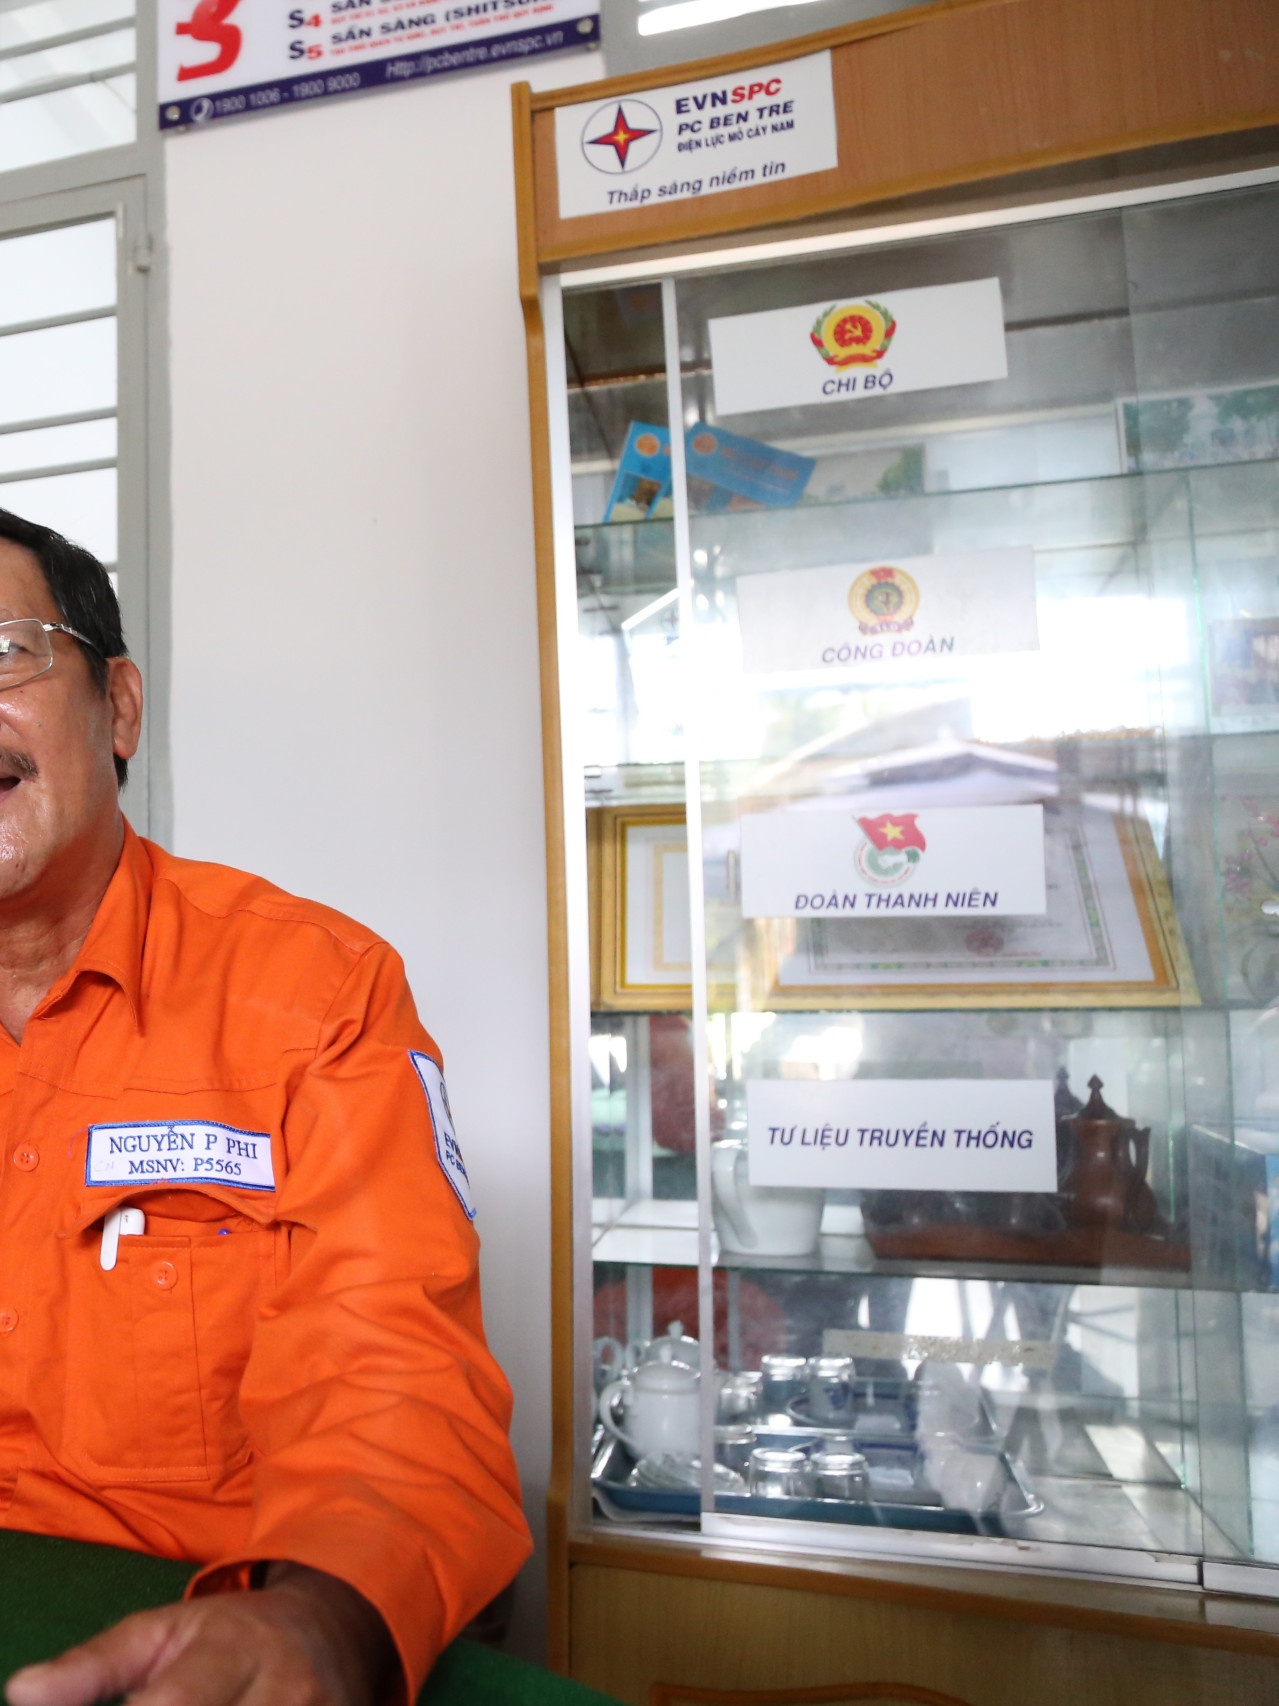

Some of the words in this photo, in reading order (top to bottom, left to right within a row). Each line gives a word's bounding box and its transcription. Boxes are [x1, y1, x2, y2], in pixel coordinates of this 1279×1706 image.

[288, 9, 322, 29] S4
[288, 40, 324, 59] S5
[215, 94, 246, 113] 1900
[249, 88, 281, 107] 1006
[292, 79, 325, 98] 1900
[326, 72, 361, 92] 9000
[675, 78, 782, 115] EVNSPC
[677, 121, 703, 137] PC
[709, 111, 750, 129] BEN
[756, 100, 795, 120] TRE
[677, 136, 702, 153] ĐIỆN
[705, 133, 725, 149] LỰC
[771, 119, 795, 133] NAM
[658, 178, 703, 197] sáng
[709, 166, 755, 190] niềm
[762, 161, 787, 177] tin
[822, 376, 857, 395] CHI
[863, 368, 893, 391] BỘ
[822, 640, 884, 664] CÔNG
[794, 889, 857, 910] ĐOÀN
[864, 891, 938, 910] THANH
[944, 887, 999, 909] NIÊN
[204, 1133, 218, 1151] P
[225, 1137, 259, 1160] PHI
[768, 1126, 796, 1146] TƯ
[800, 1123, 849, 1150] LIỆU
[857, 1121, 946, 1148] TRUYỀN
[953, 1121, 1034, 1149] THỐNG
[128, 1158, 185, 1175] MSNV:
[192, 1157, 243, 1176] P5565
